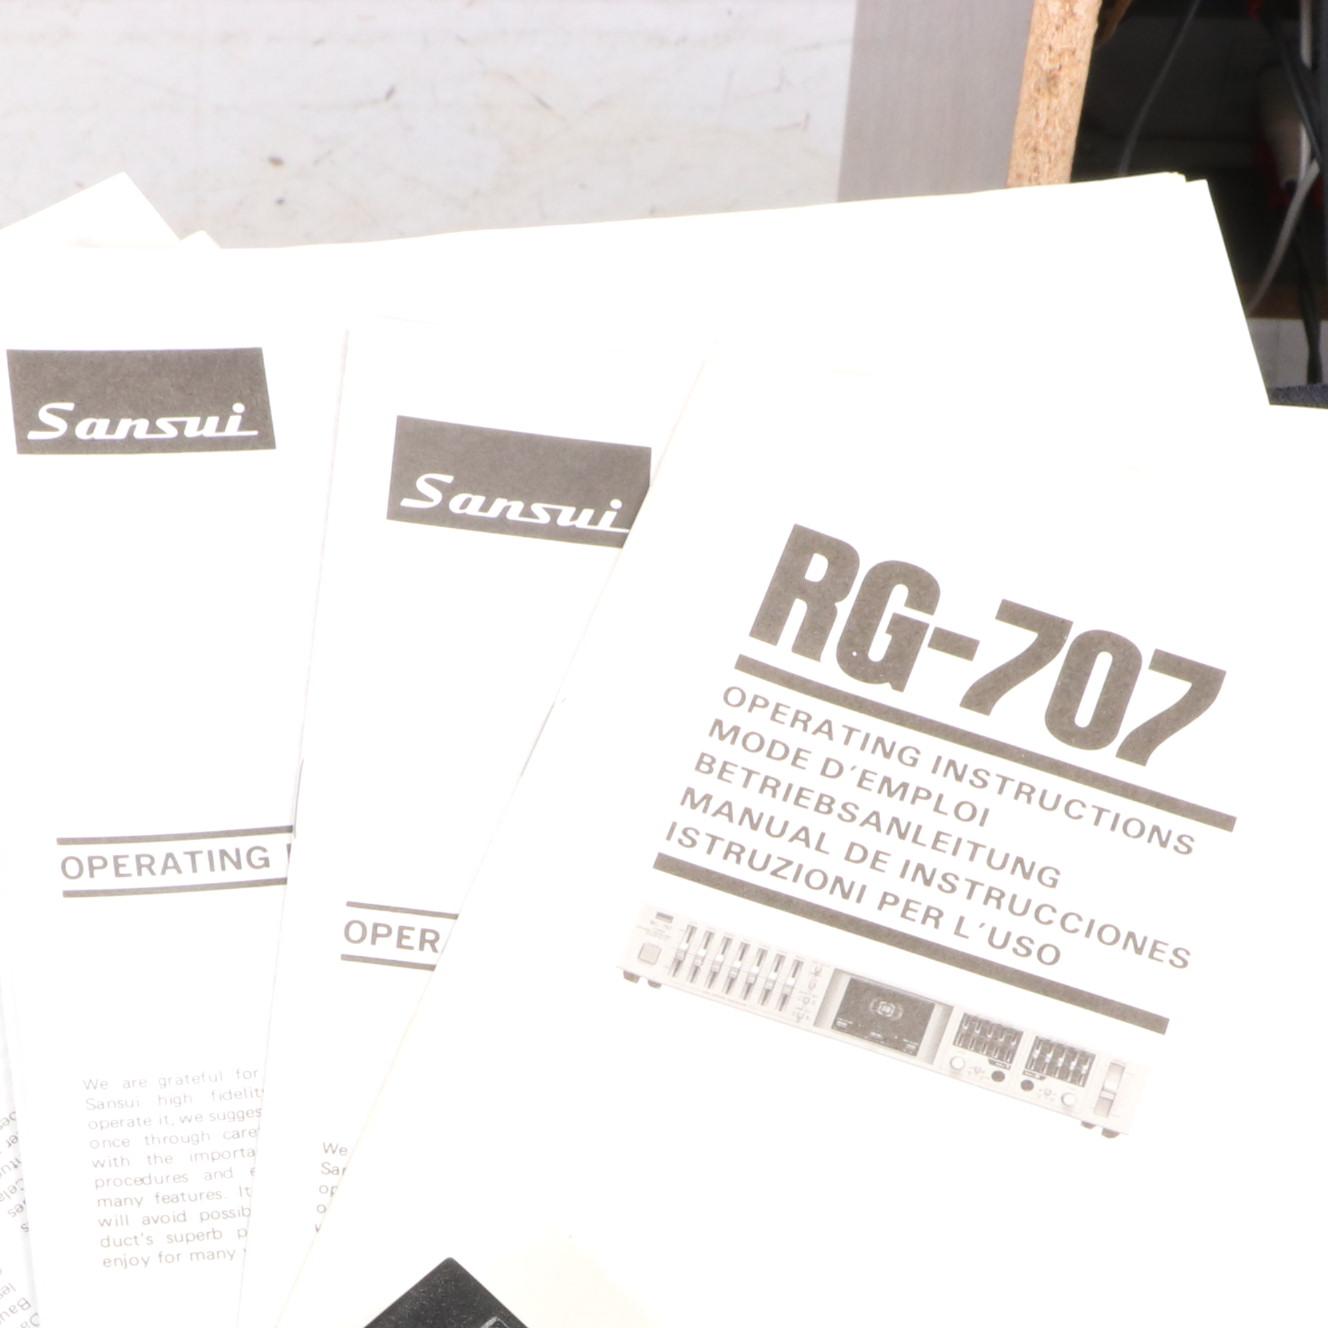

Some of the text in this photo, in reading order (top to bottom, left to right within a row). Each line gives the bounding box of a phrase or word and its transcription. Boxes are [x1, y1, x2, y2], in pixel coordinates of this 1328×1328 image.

[25, 400, 259, 441] Sansui
[398, 471, 630, 534] Sansui
[747, 522, 1227, 767] RG-707
[707, 717, 812, 770] MODE
[721, 685, 1195, 856] OPERATING INSTRUCTIONS
[693, 750, 1061, 889] BETRIEBSANLEITUNG
[59, 844, 271, 880] OPERATING
[664, 820, 867, 905] ISTRUZIONI
[876, 890, 944, 930] PER
[678, 785, 1191, 969] MANUAL DE INSTRUCCIONES
[84, 1096, 141, 1111] Sansui
[209, 1086, 265, 1102] fidelit
[86, 1115, 153, 1131] operate
[181, 1112, 204, 1125] we
[88, 1136, 131, 1150] once
[143, 1129, 211, 1146] through
[90, 1154, 131, 1169] with
[145, 1152, 174, 1166] the
[93, 1165, 234, 1191] procedures and
[96, 1195, 144, 1208] many
[96, 1213, 129, 1228] will
[140, 1208, 188, 1226] avoid
[164, 1226, 223, 1245] superb
[101, 1248, 236, 1270] enjoy for many
